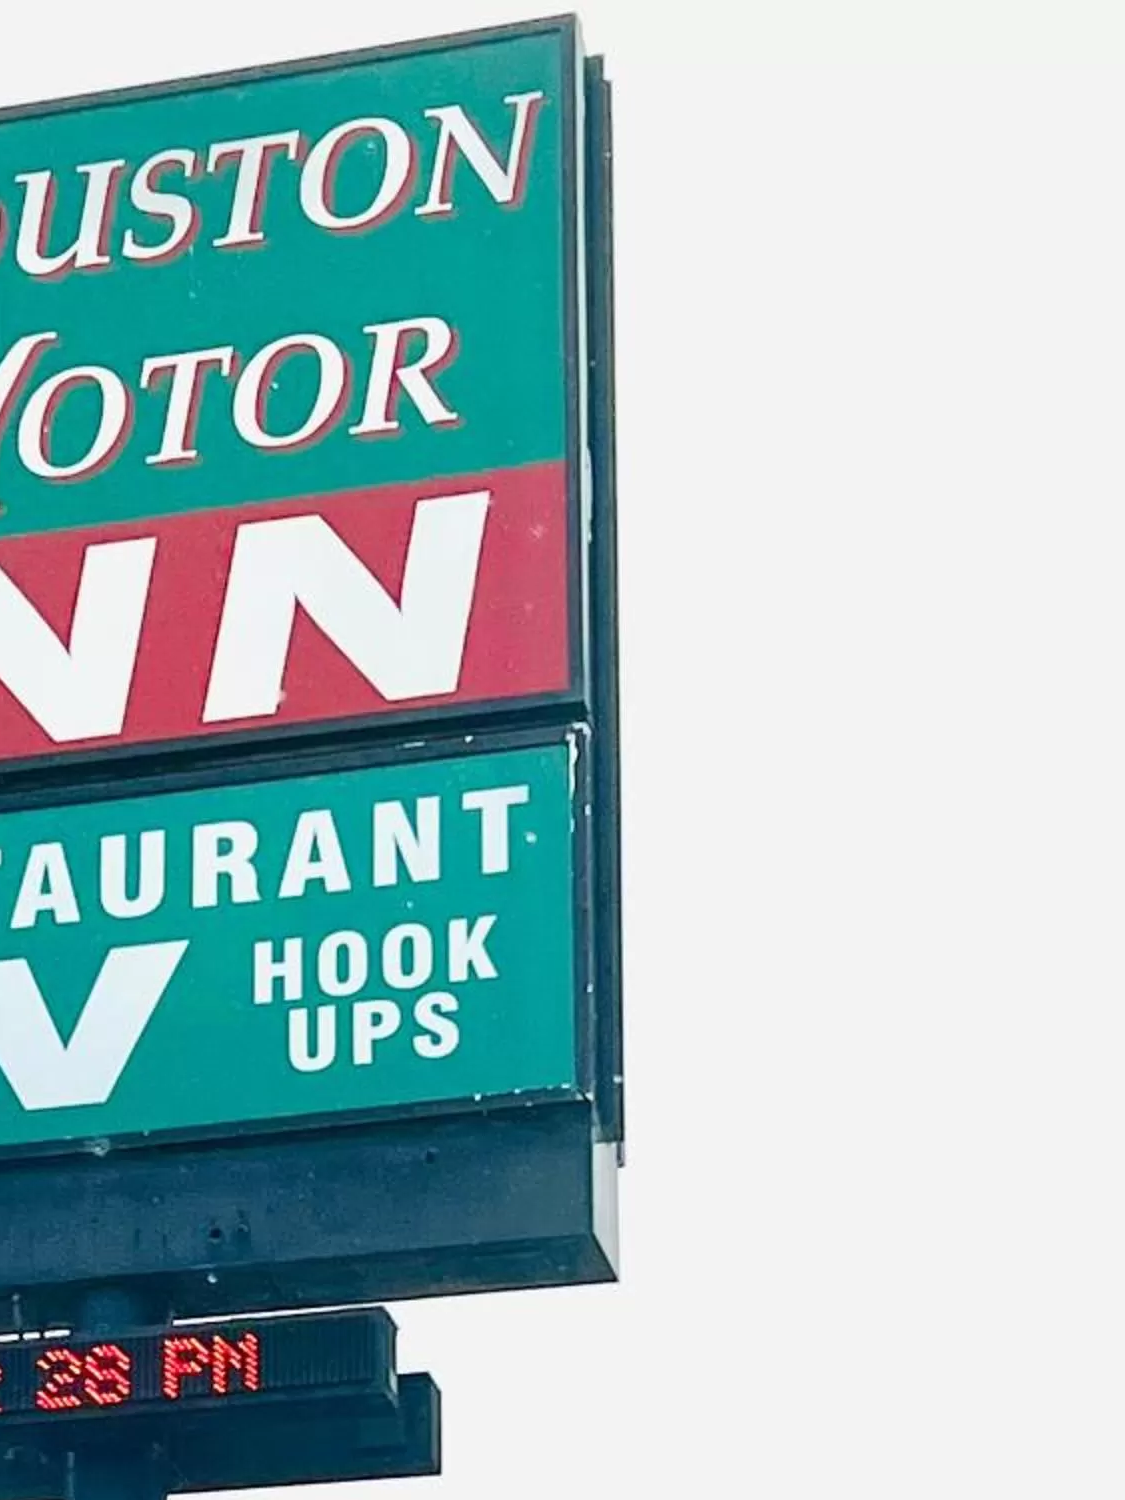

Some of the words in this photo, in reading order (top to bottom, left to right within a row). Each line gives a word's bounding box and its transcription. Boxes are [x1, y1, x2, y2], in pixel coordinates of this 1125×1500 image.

[253, 915, 498, 1006] HOOK
[287, 993, 459, 1071] UPS
[162, 1333, 260, 1398] PM
